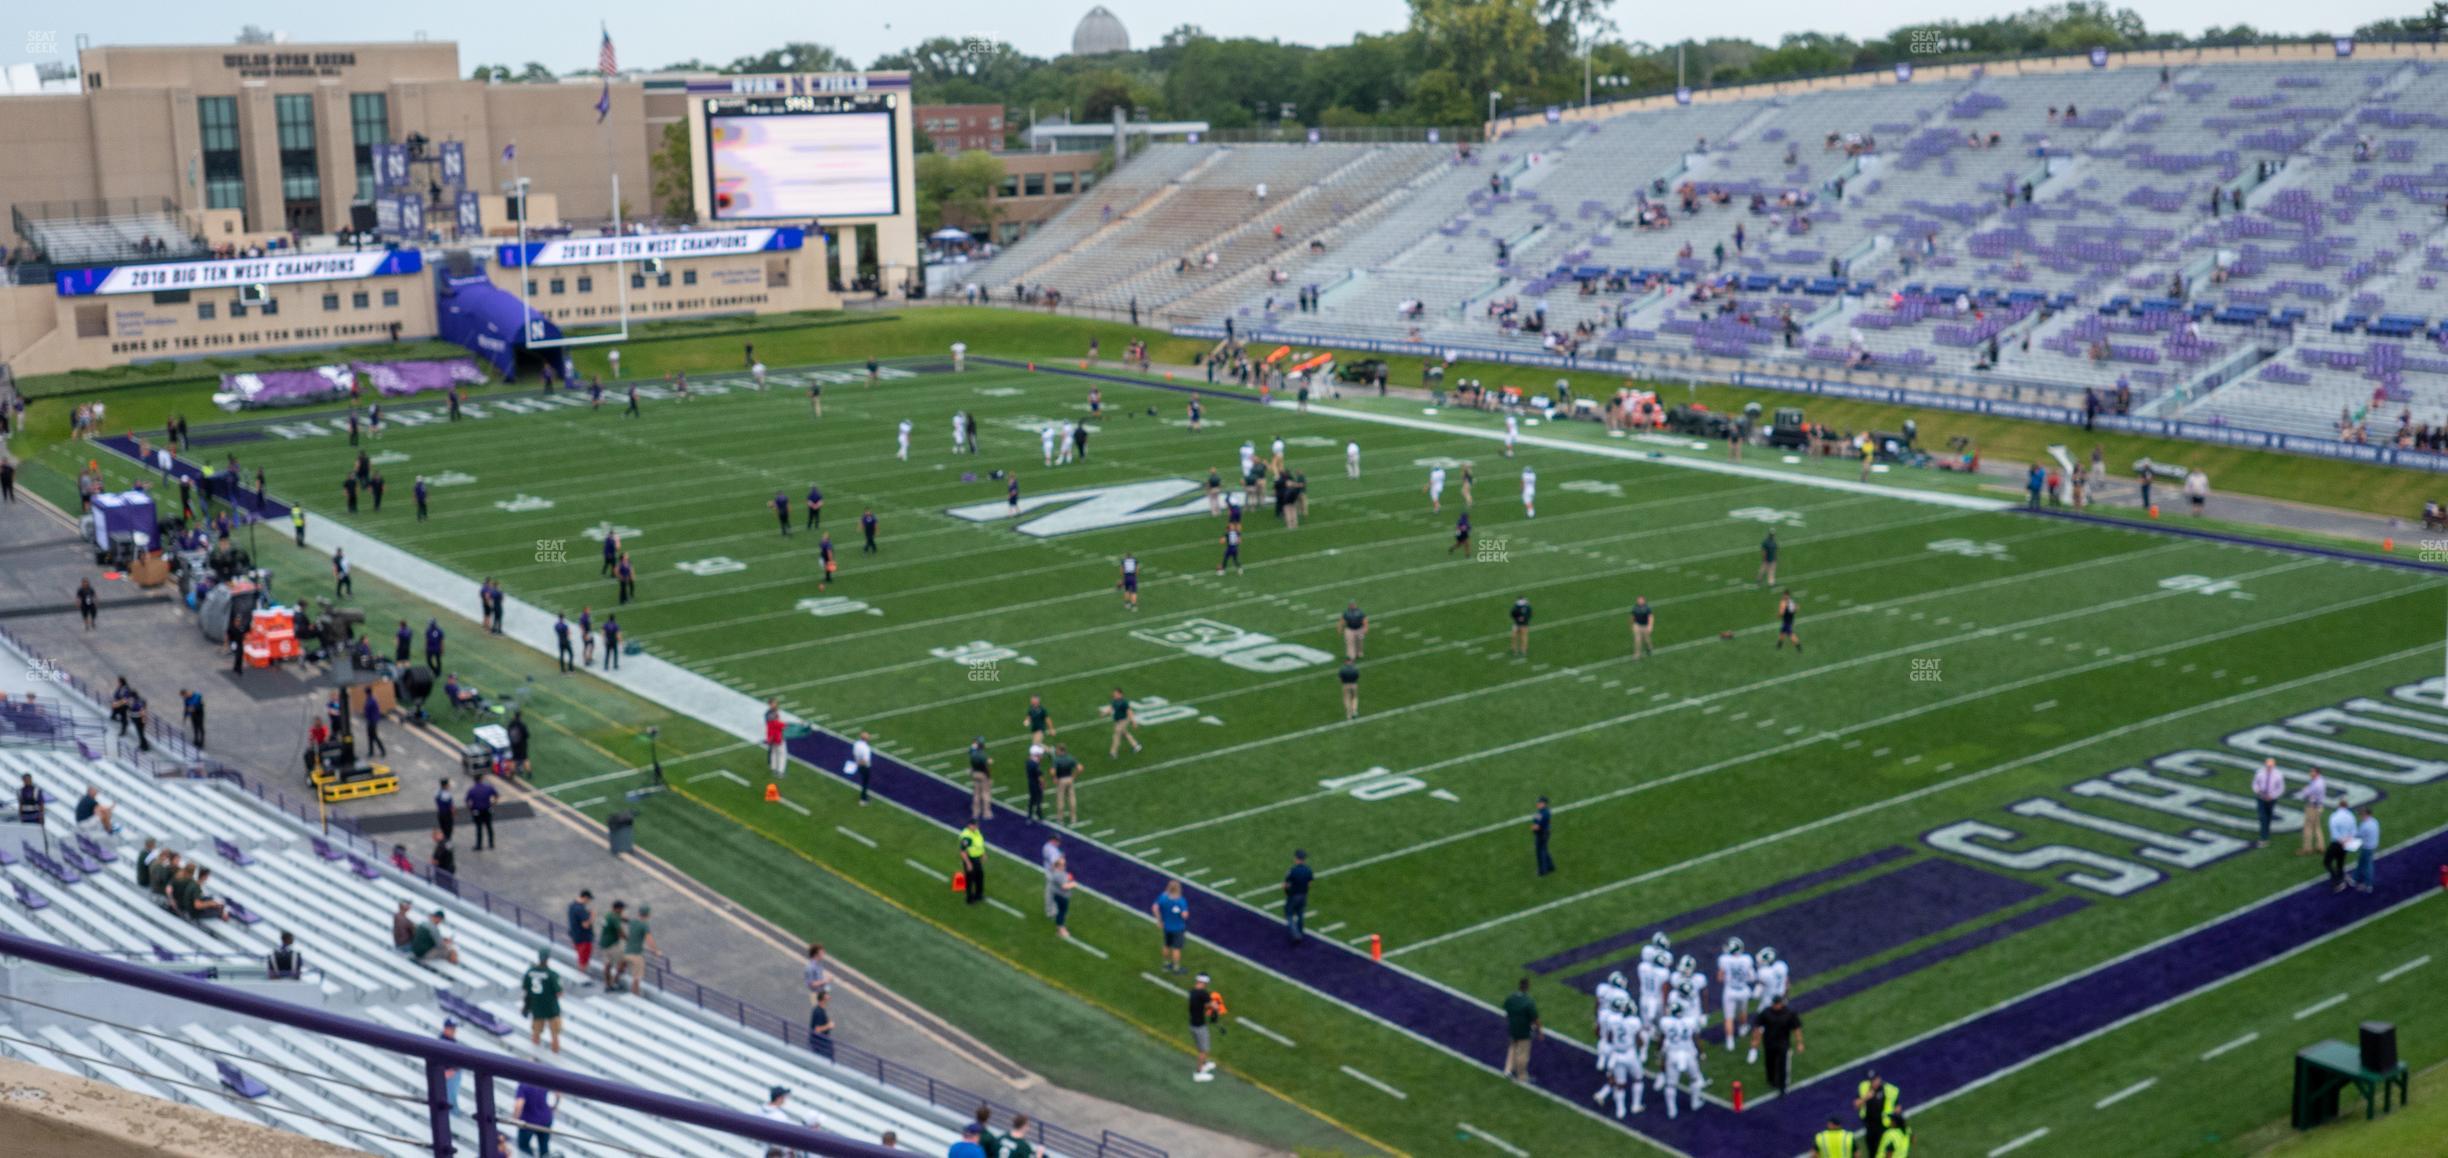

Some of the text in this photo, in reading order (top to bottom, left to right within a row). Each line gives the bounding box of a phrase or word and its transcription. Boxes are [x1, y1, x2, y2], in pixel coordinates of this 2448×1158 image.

[596, 243, 615, 257] BIG
[621, 241, 641, 255] TEN
[648, 238, 676, 253] WEST
[682, 235, 748, 251] CHAMPIONS
[131, 258, 356, 287] 2018 BIG TEN WEST CHAMPIONS
[334, 321, 403, 337] CHAMPIOS
[1318, 766, 1427, 801] 10
